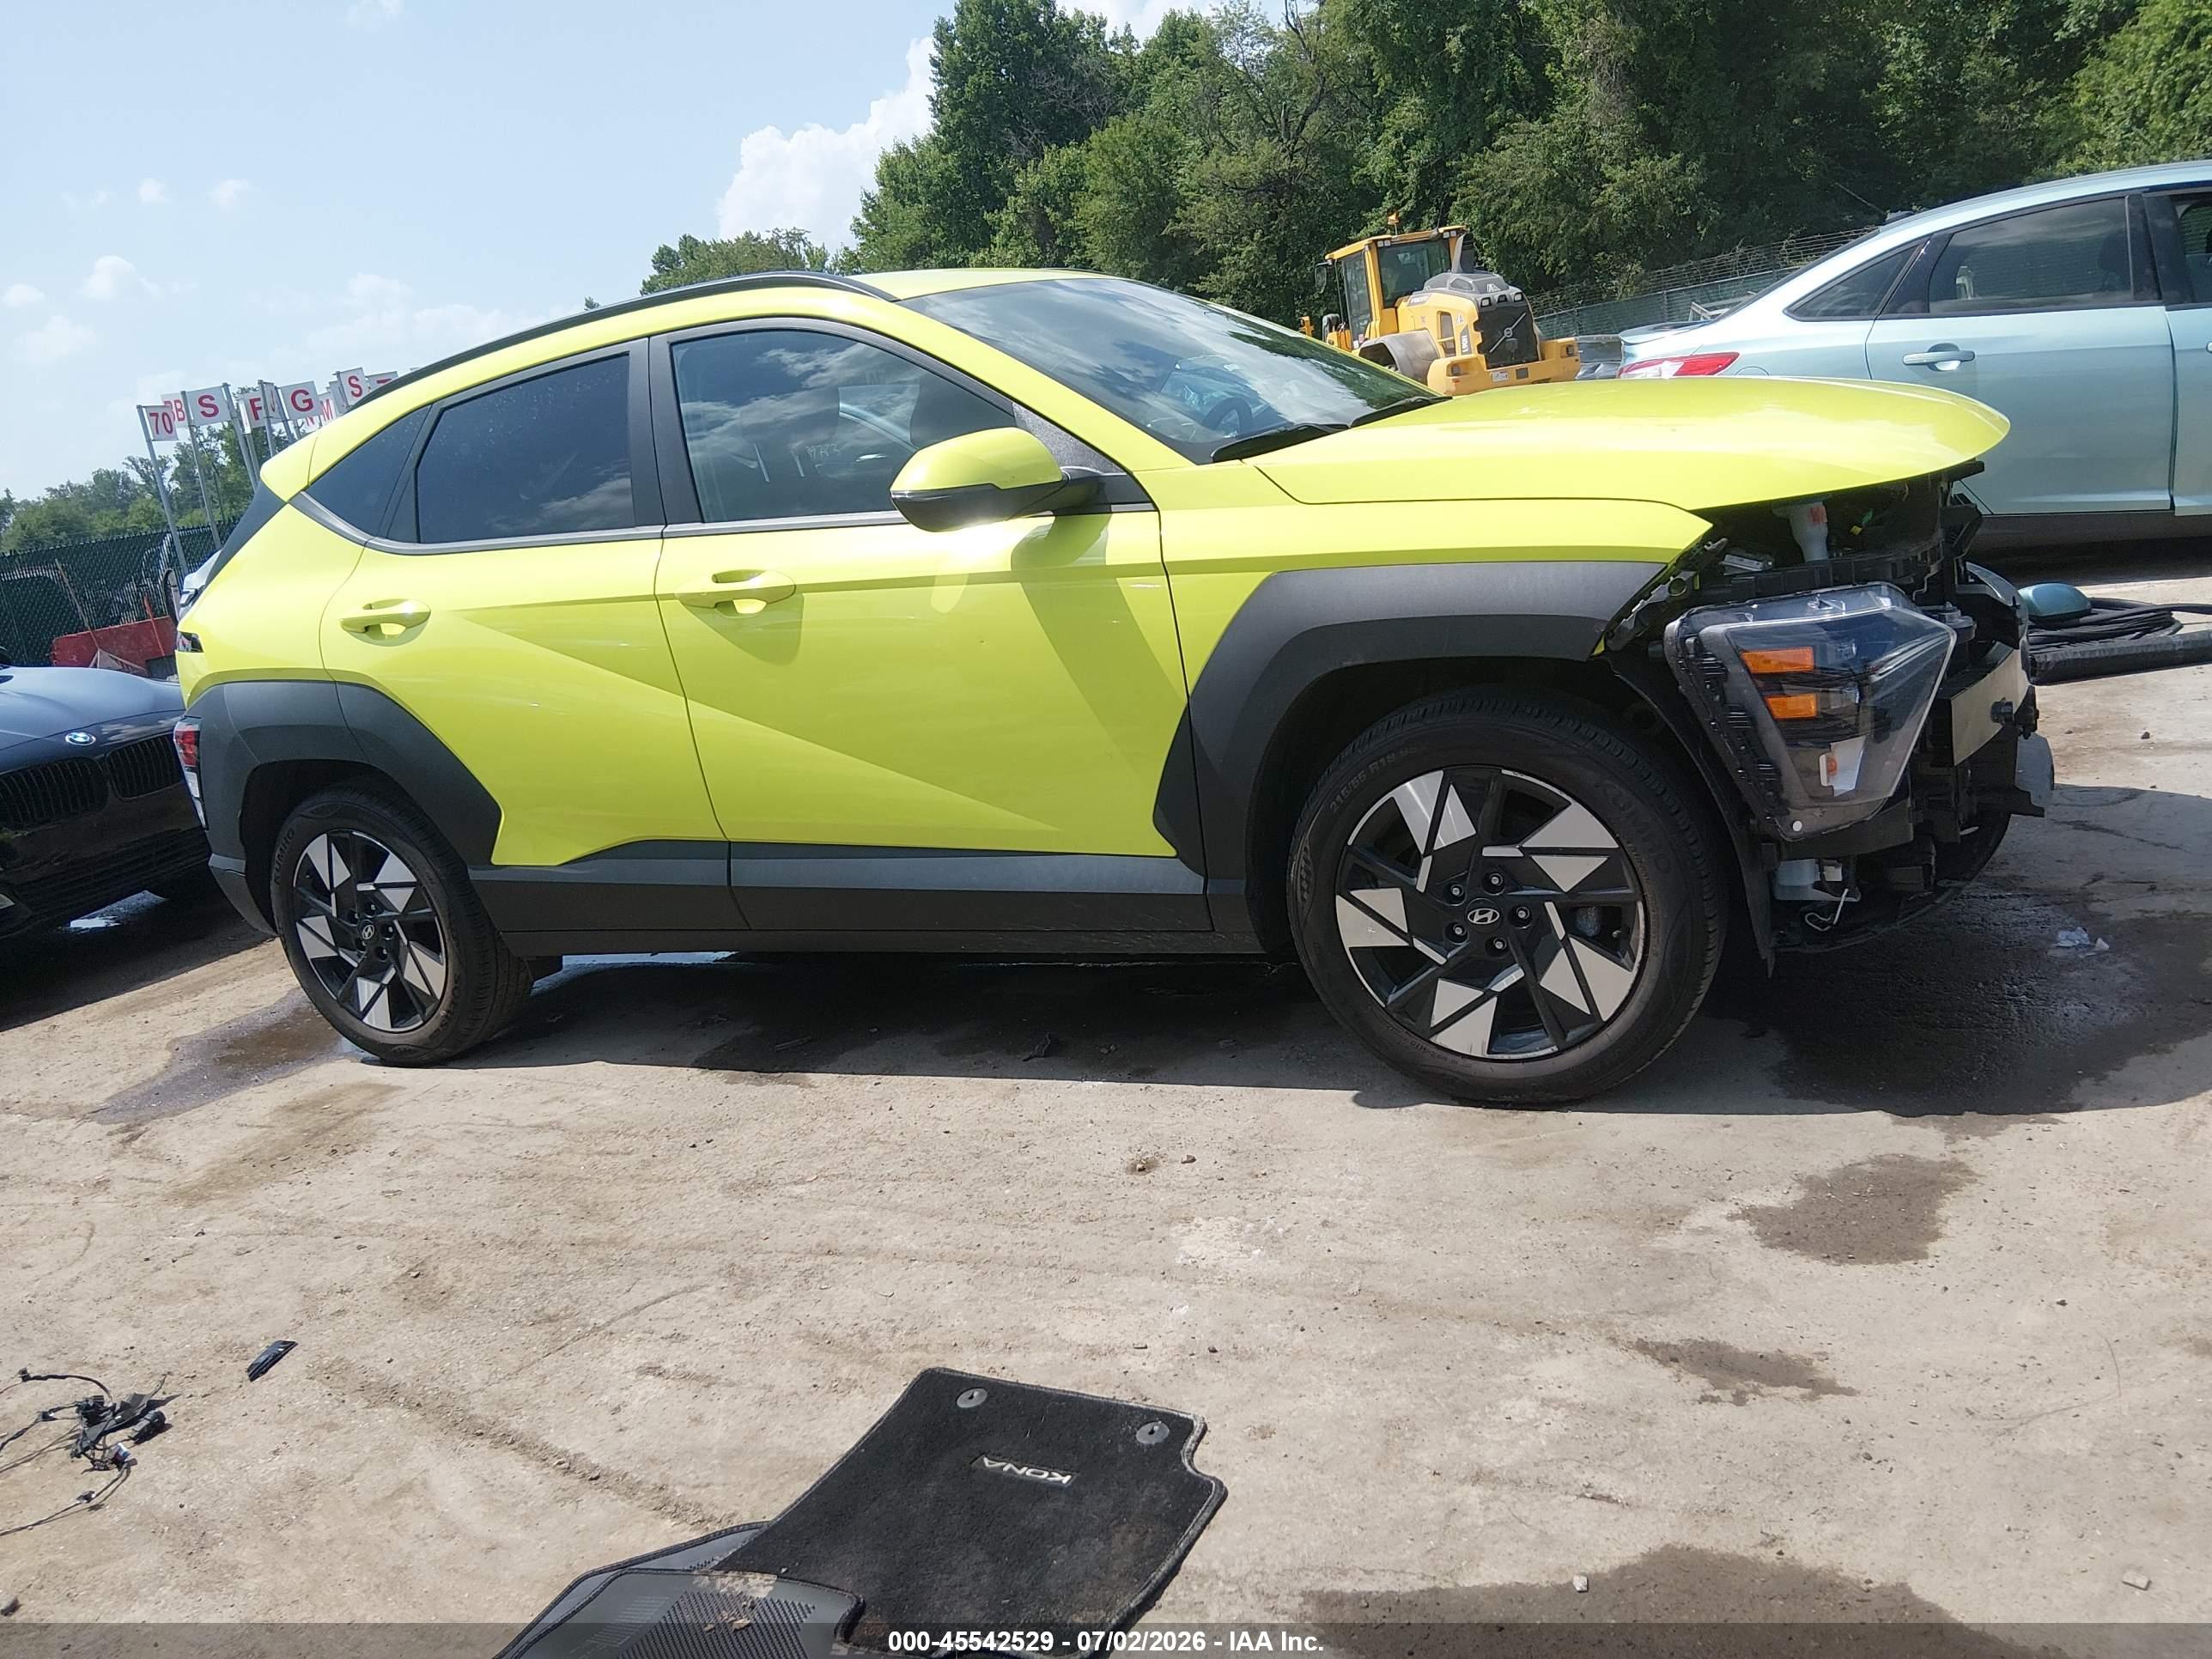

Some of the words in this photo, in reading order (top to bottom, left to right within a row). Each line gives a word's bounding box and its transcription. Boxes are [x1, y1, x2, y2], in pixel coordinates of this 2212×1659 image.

[348, 375, 363, 398] S
[198, 394, 220, 418] S
[249, 397, 263, 421] F
[290, 389, 314, 412] G
[149, 412, 173, 434] 70
[274, 828, 295, 886] KUMHO
[982, 1456, 1073, 1485] KONA
